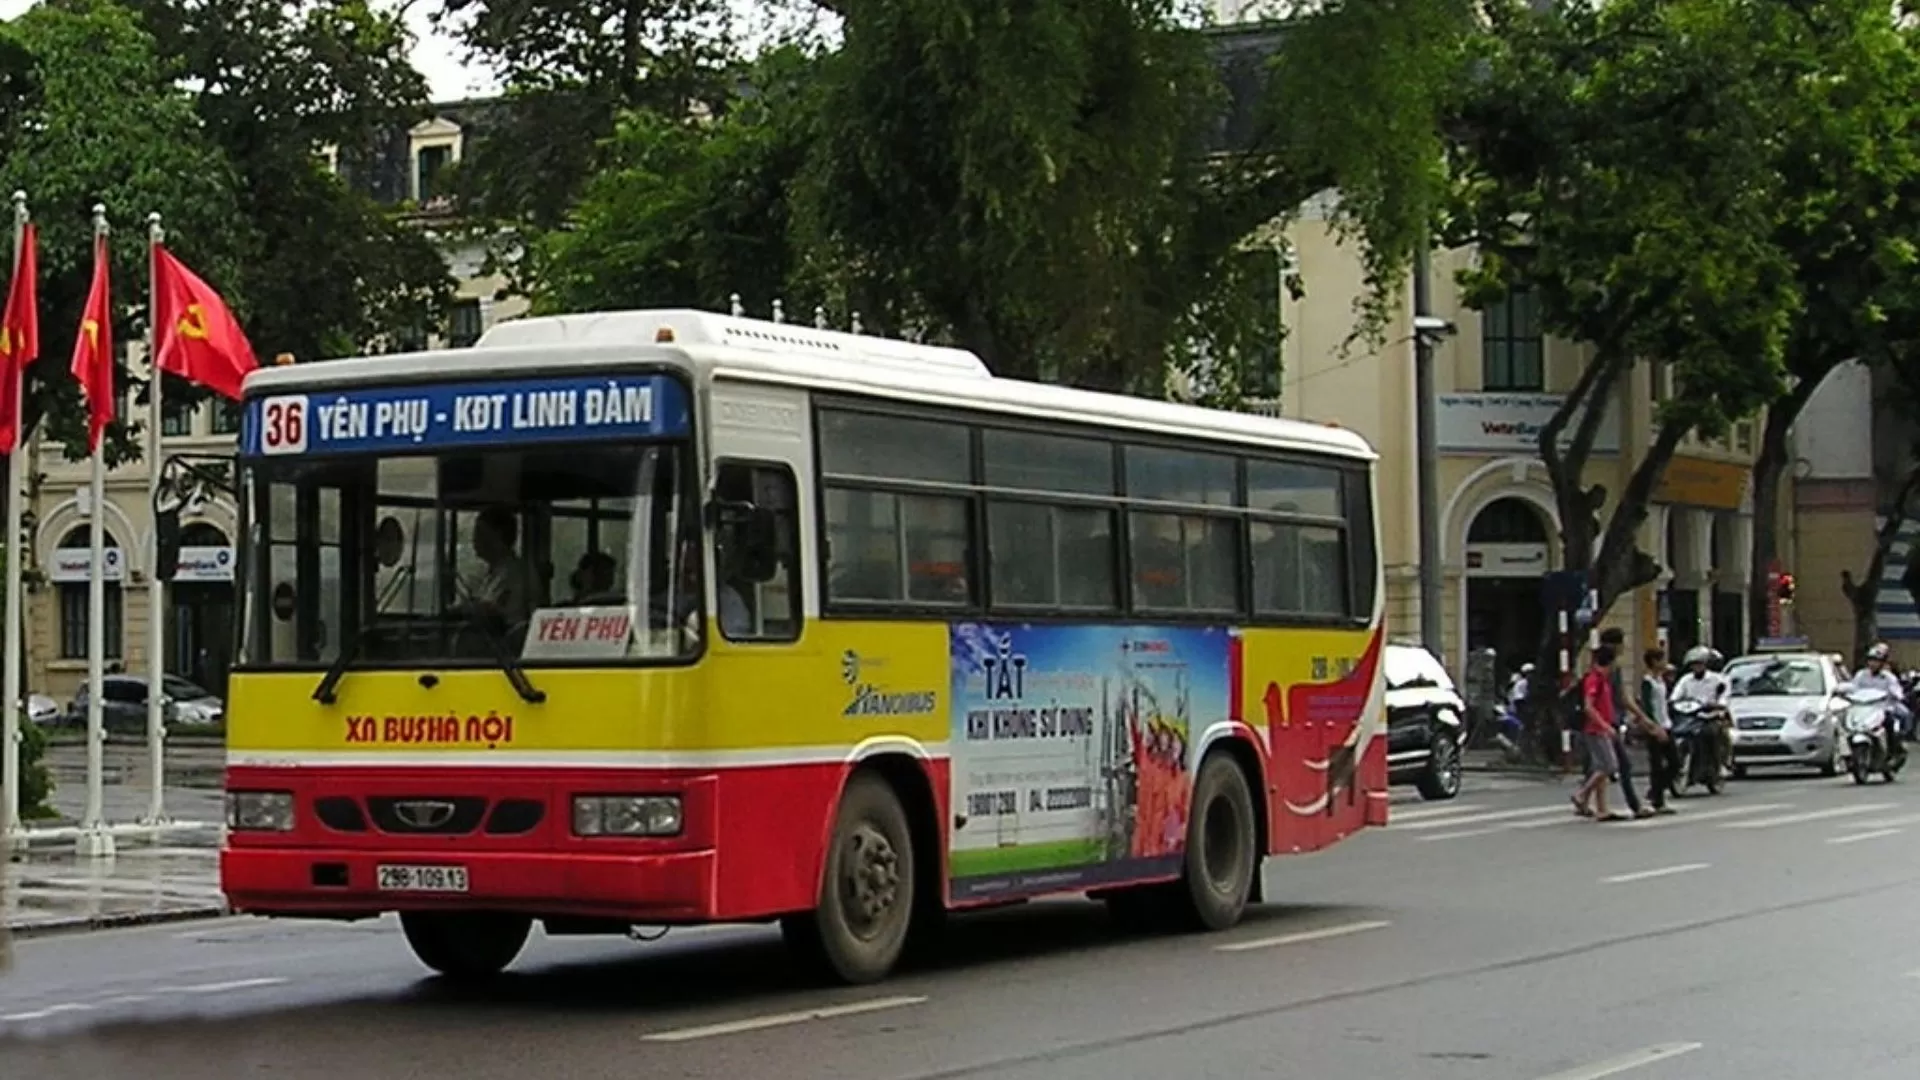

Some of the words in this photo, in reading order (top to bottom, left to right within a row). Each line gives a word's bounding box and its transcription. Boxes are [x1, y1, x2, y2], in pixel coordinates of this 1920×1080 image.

[265, 403, 302, 447] 36
[318, 398, 367, 439] YÊN
[375, 400, 428, 443] PHỤ
[453, 396, 506, 432] KĐT
[513, 391, 577, 428] LINH
[584, 381, 652, 425] ĐÀM
[538, 611, 580, 641] YÊN
[584, 614, 630, 646] PHỤ
[983, 635, 1026, 699] TẮT
[465, 710, 512, 749] NỘI
